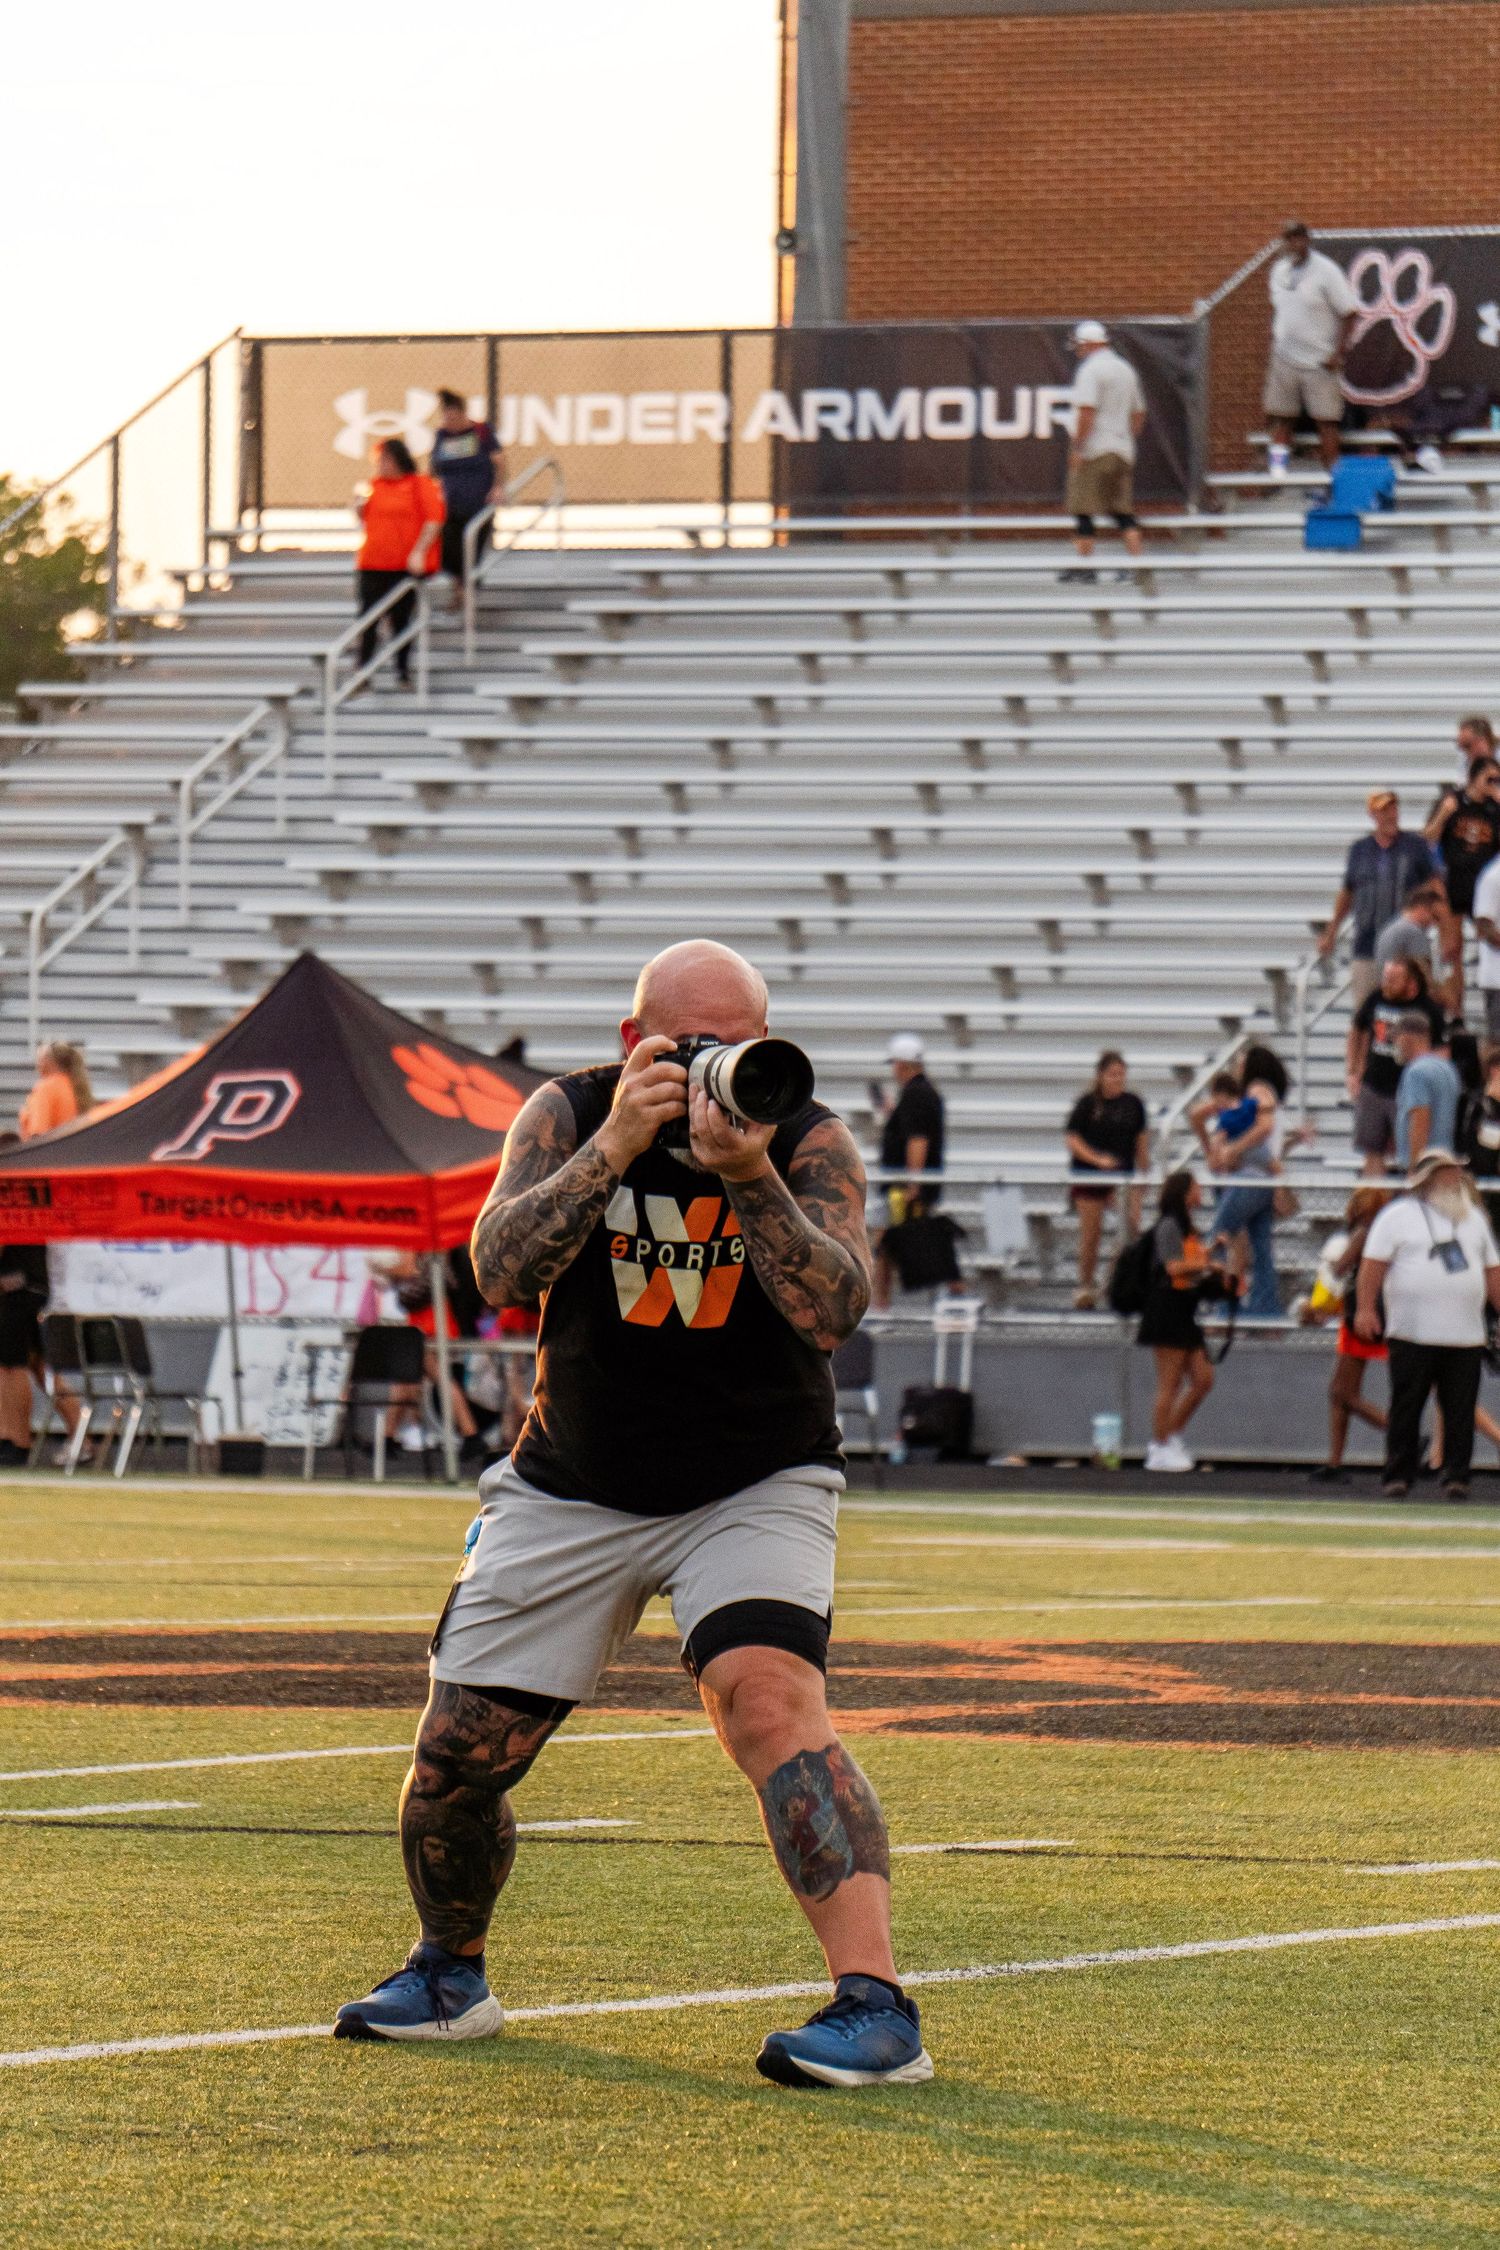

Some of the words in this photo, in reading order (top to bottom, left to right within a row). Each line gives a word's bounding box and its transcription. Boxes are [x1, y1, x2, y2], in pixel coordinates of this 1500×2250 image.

[741, 386, 1079, 443] ARMOUR
[151, 1068, 301, 1161] P
[610, 1233, 746, 1270] SPORTS
